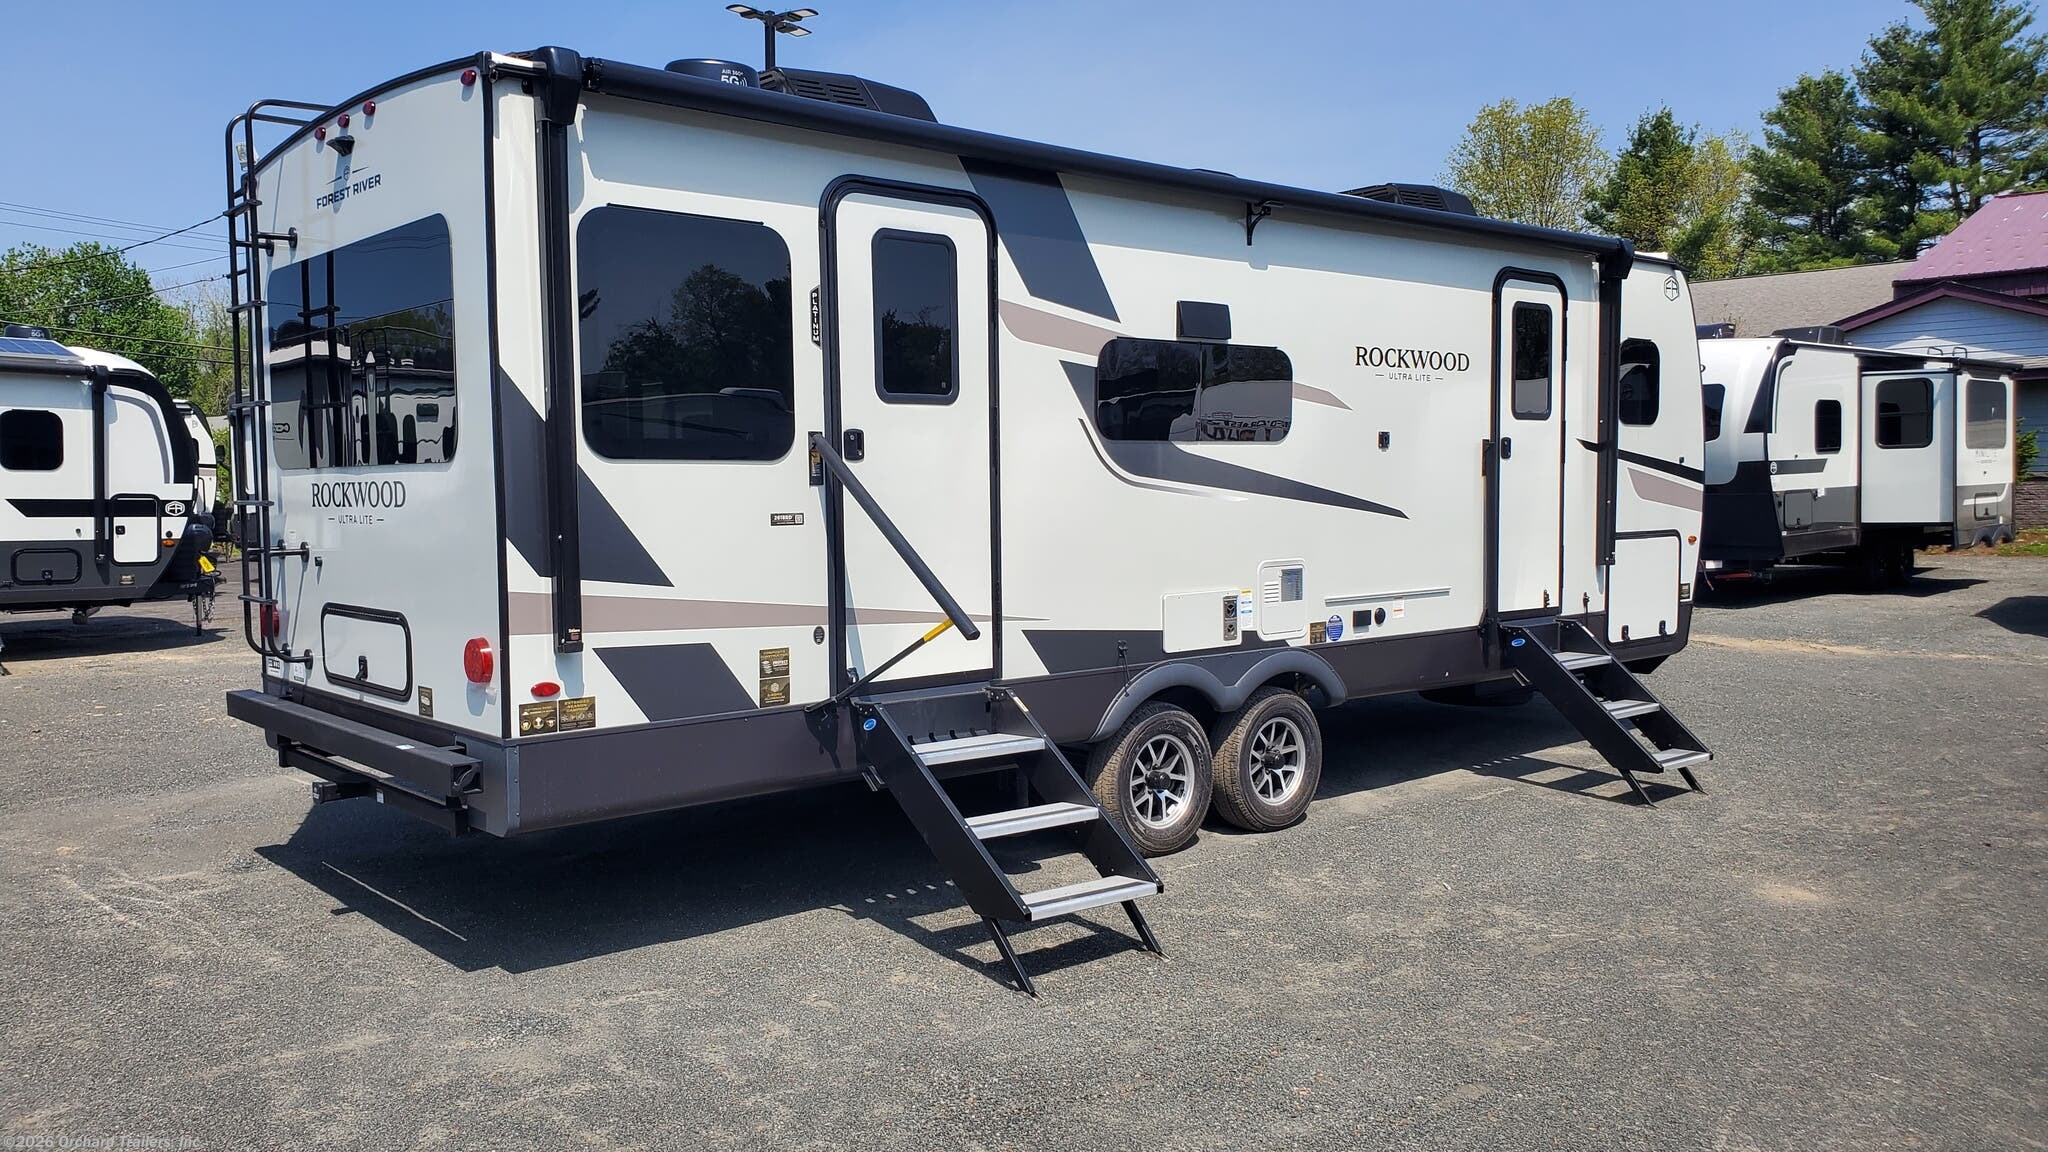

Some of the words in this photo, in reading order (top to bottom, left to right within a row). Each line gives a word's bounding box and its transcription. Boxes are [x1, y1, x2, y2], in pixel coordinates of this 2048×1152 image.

[316, 186, 351, 209] FOREST
[352, 174, 381, 195] RIVER
[811, 292, 820, 342] PLATINUM
[1355, 346, 1470, 372] ROCKWOOD
[1388, 372, 1413, 381] ULTRA
[1415, 374, 1431, 382] LITE
[311, 480, 406, 508] ROCKWOOD
[338, 514, 357, 524] ULTRA
[359, 515, 373, 525] LITE
